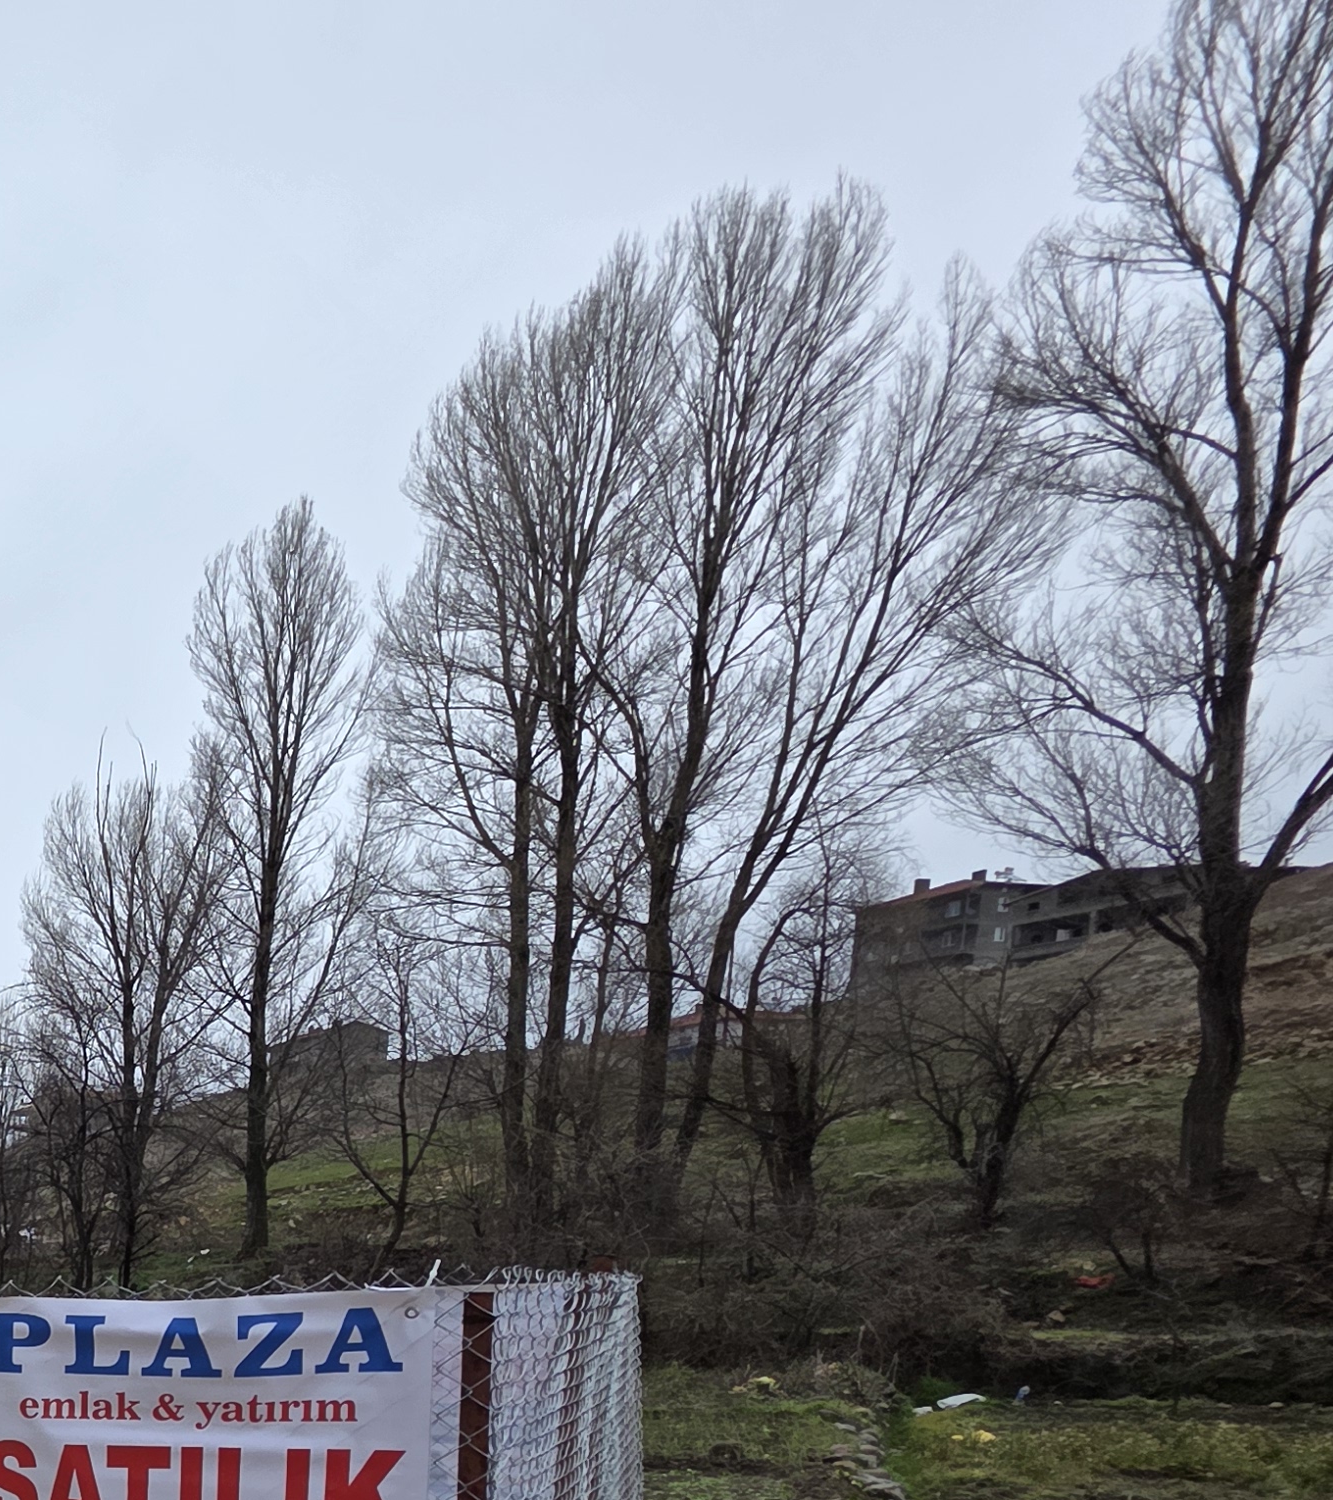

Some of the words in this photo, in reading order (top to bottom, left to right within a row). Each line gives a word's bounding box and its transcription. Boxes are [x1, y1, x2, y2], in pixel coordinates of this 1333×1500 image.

[19, 1391, 141, 1421] emlak
[152, 1394, 184, 1422] &
[195, 1395, 358, 1430] yatırım
